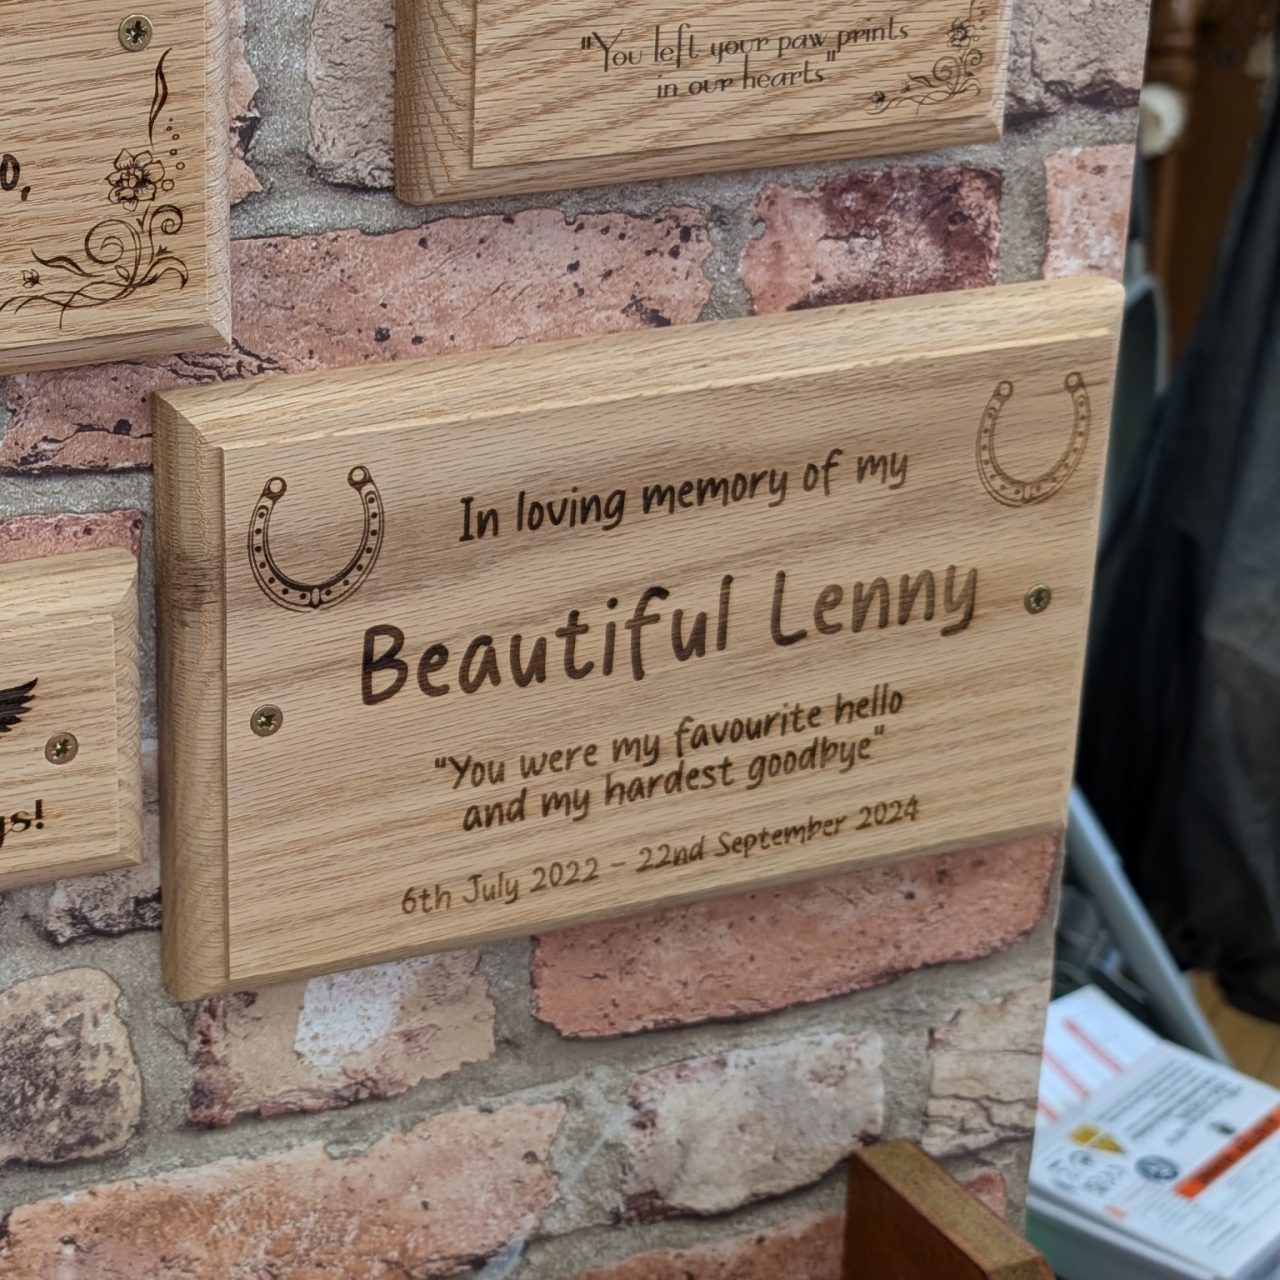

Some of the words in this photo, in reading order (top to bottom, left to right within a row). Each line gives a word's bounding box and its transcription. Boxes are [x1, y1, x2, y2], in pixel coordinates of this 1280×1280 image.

[581, 31, 642, 72] "You
[654, 23, 700, 68] left
[710, 35, 769, 64] your
[777, 32, 828, 57] paw
[836, 17, 910, 54] prints
[657, 74, 678, 99] in
[688, 77, 733, 95] our
[742, 50, 836, 90] hearts"
[459, 497, 499, 542] In
[517, 486, 625, 531] loving
[641, 471, 787, 515] memory
[803, 448, 843, 496] of
[856, 450, 909, 489] my
[362, 574, 733, 706] Beautiful
[770, 564, 978, 646] Lenny
[434, 754, 506, 790] "You
[519, 744, 599, 778] were
[612, 734, 660, 767] my
[674, 703, 821, 759] favourite
[834, 683, 903, 720] hello
[462, 788, 527, 832] and
[541, 787, 591, 823] my
[604, 756, 734, 807] hardest
[746, 725, 885, 787] goodbye"
[401, 884, 451, 915] 6th
[462, 871, 518, 906] July
[530, 858, 600, 892] 2022
[636, 836, 704, 873] 22nd
[714, 814, 848, 859] September
[855, 795, 920, 829] 2024
